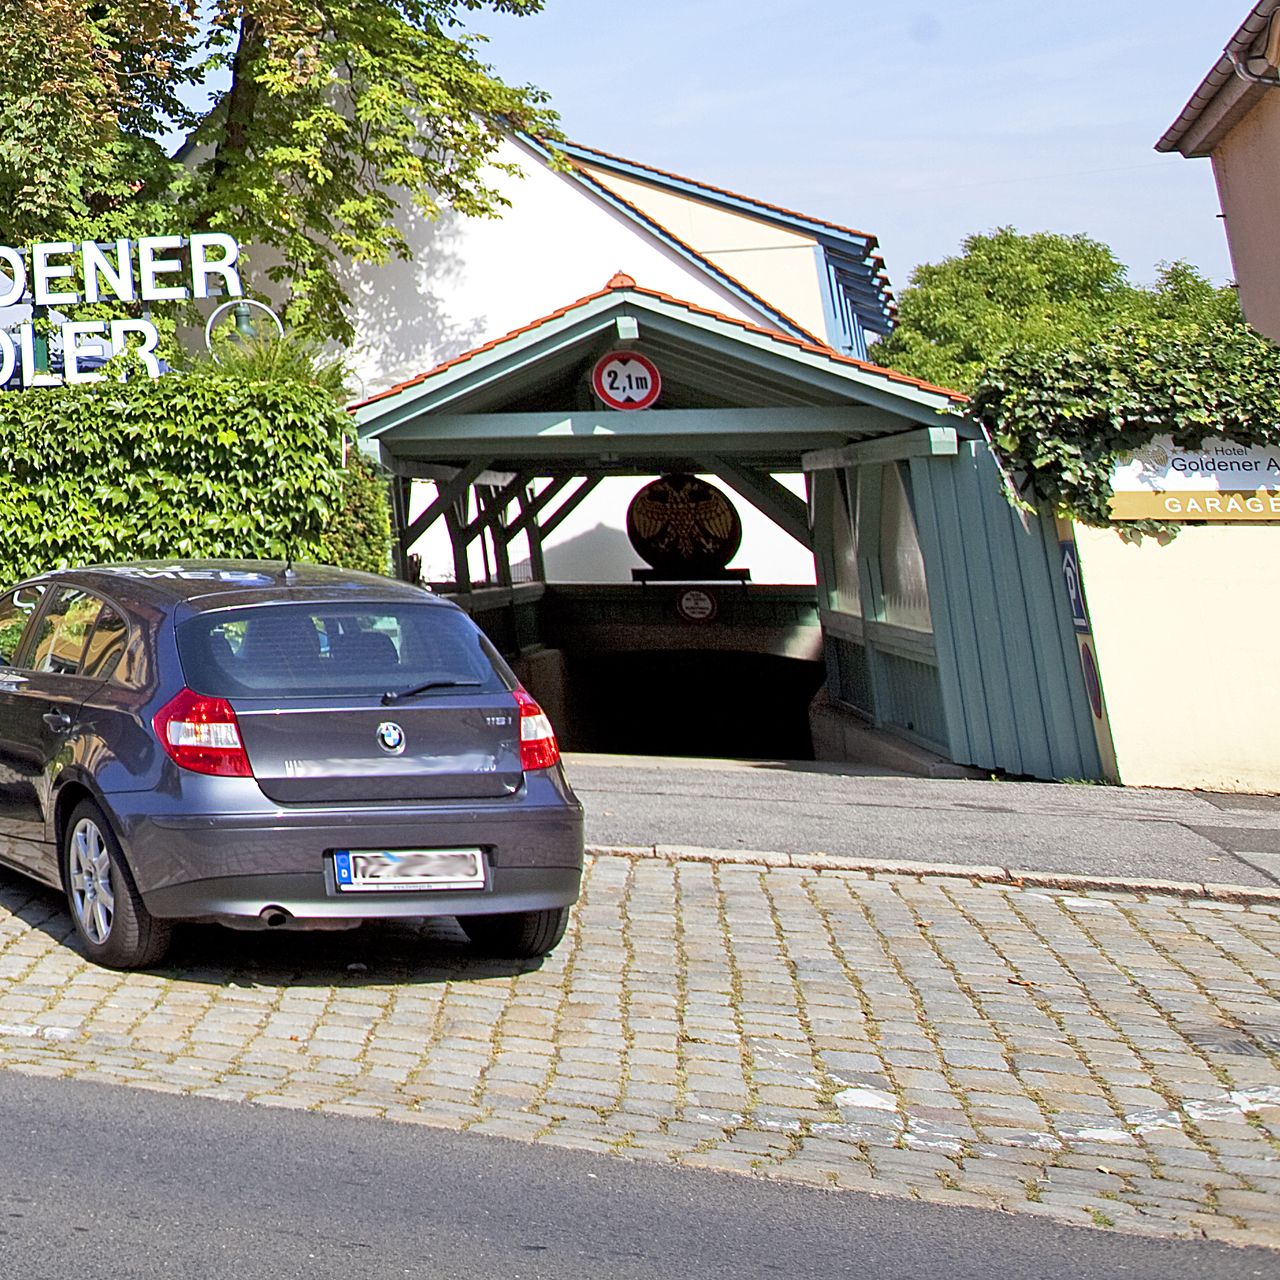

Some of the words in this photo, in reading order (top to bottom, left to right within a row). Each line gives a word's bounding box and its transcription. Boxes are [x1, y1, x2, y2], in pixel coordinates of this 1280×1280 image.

[1214, 446, 1248, 456] Hotel
[1171, 457, 1260, 471] Goldener
[1164, 497, 1280, 513] GARAGE
